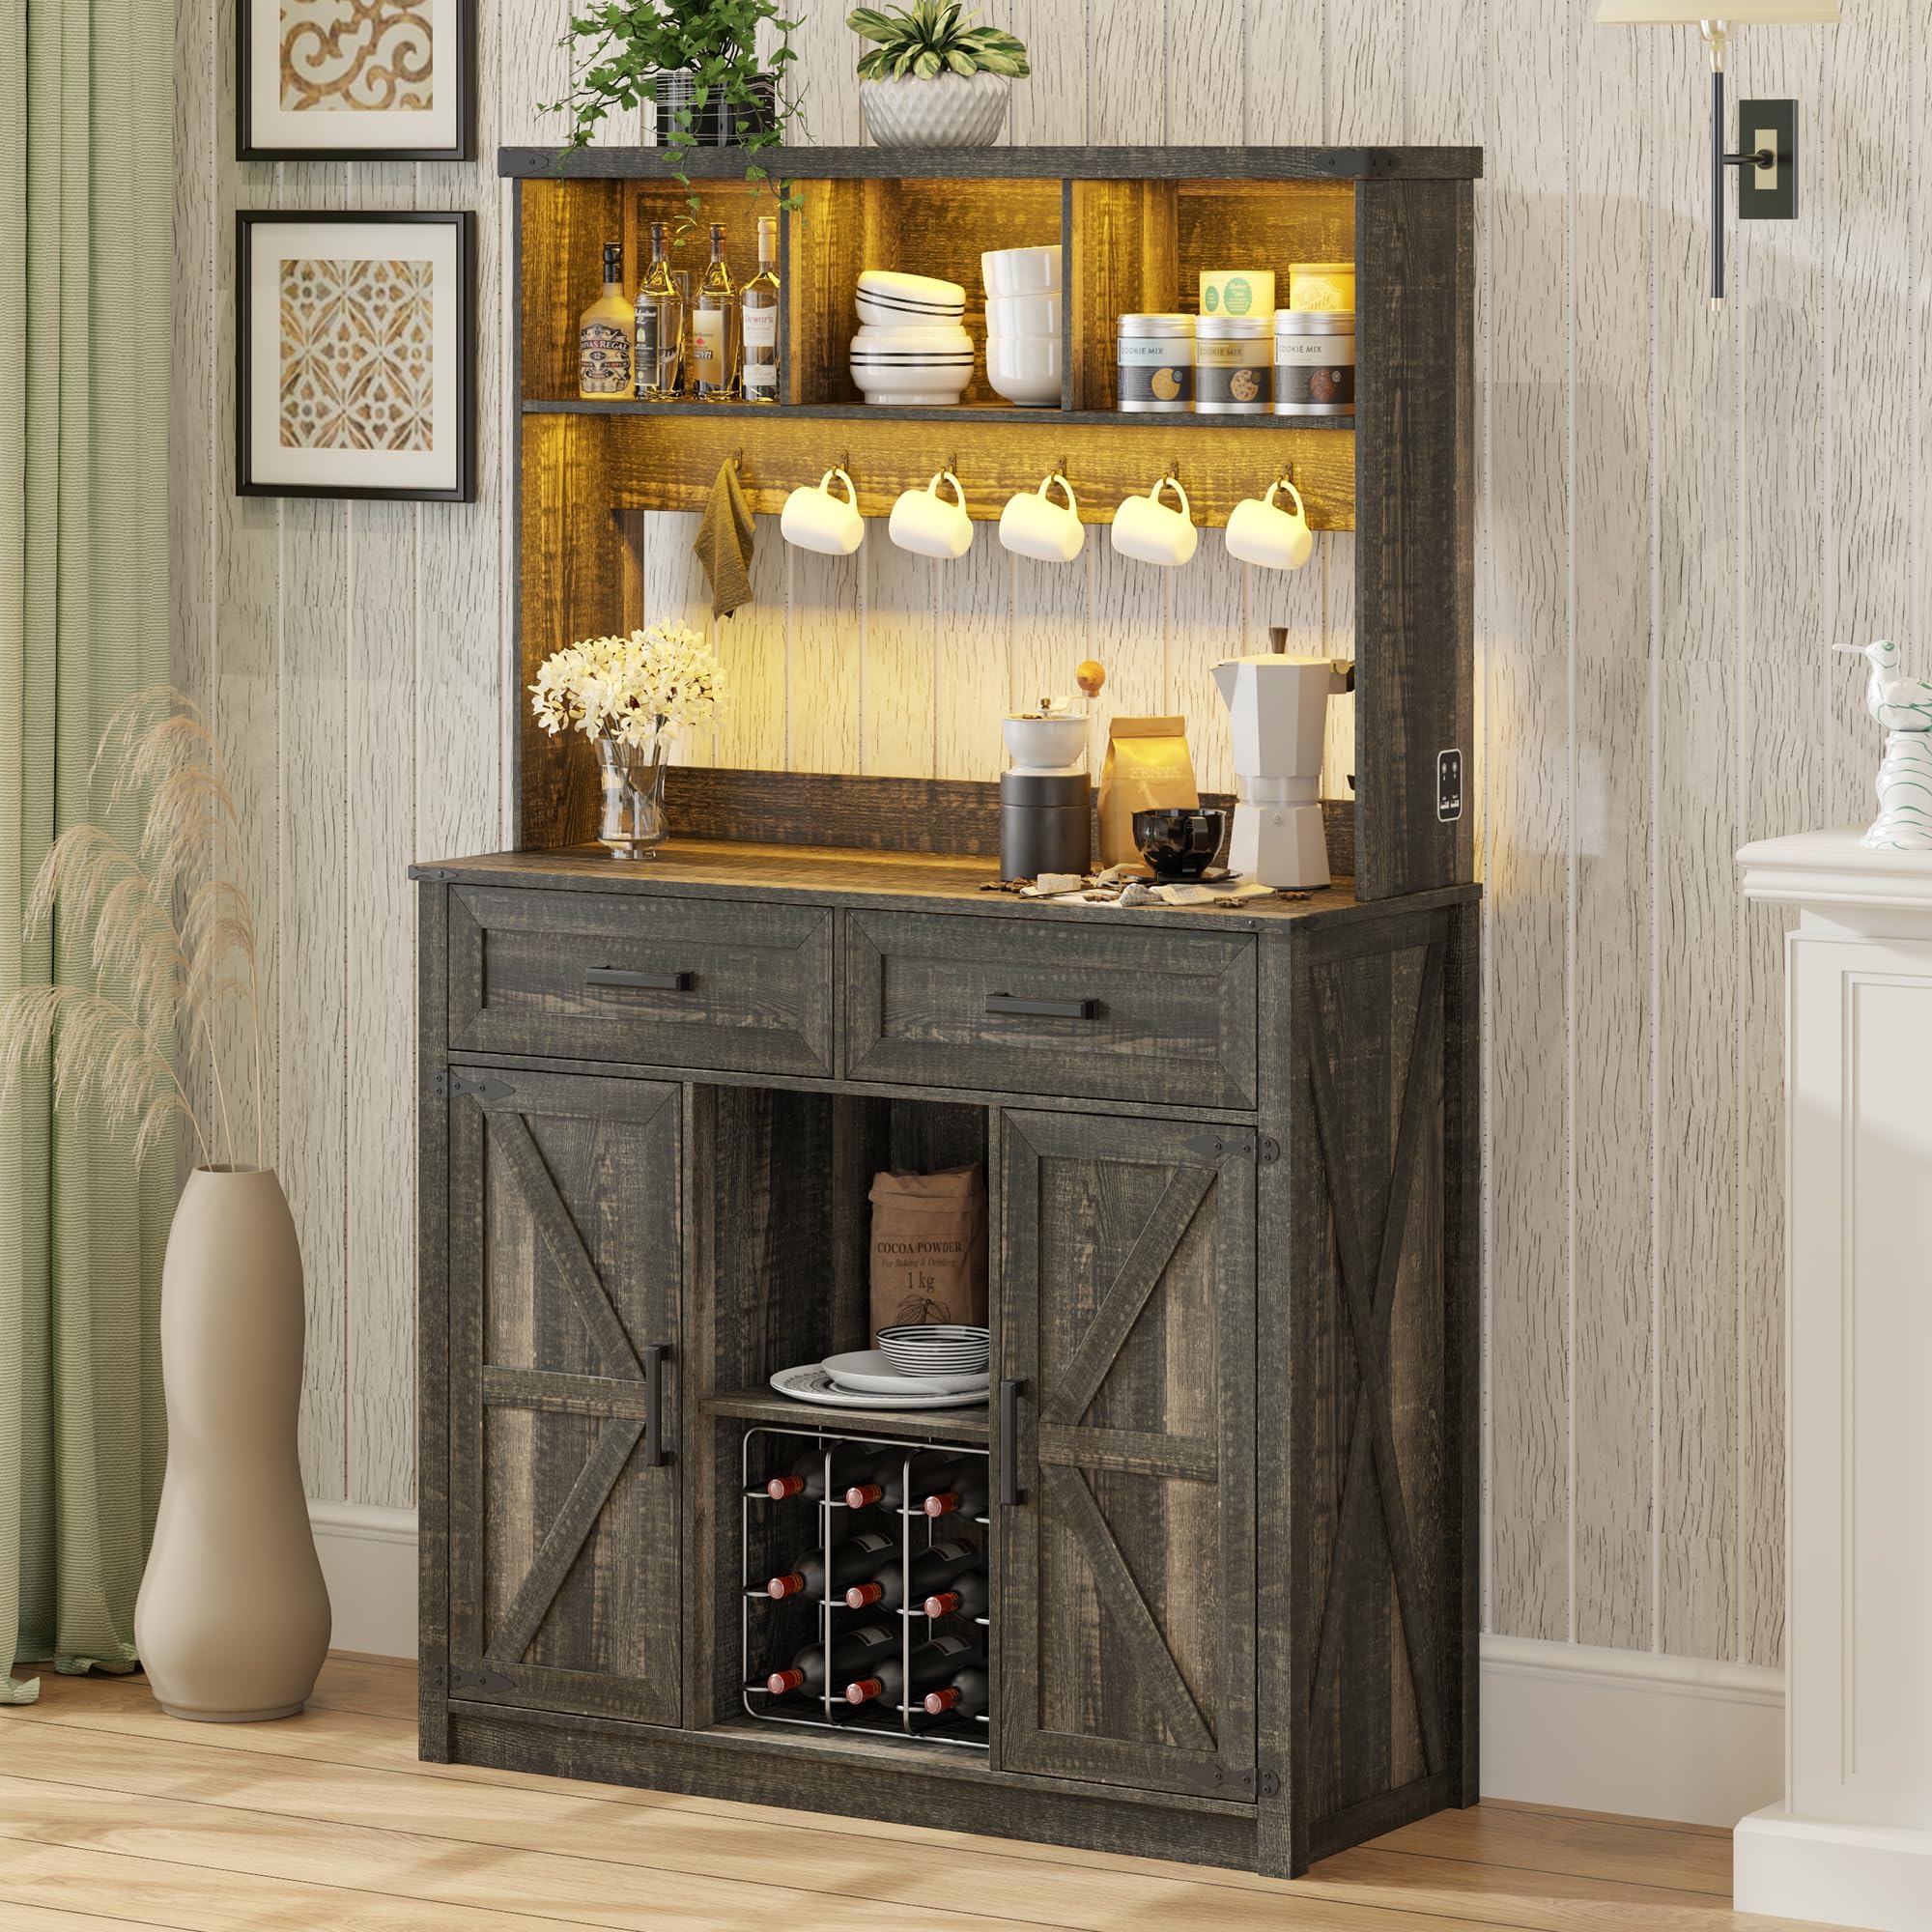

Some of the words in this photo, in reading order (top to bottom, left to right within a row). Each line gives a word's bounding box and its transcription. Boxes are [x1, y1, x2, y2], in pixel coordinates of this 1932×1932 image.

[600, 340, 628, 351] REGAL
[1278, 345, 1304, 354] COOKIE
[1305, 345, 1322, 354] MIX
[877, 1242, 914, 1253] COCOA
[918, 1241, 963, 1253] POWDER
[881, 1258, 895, 1267] For
[895, 1258, 919, 1268] Baking
[908, 1271, 913, 1289] 1
[919, 1271, 935, 1293] kg
